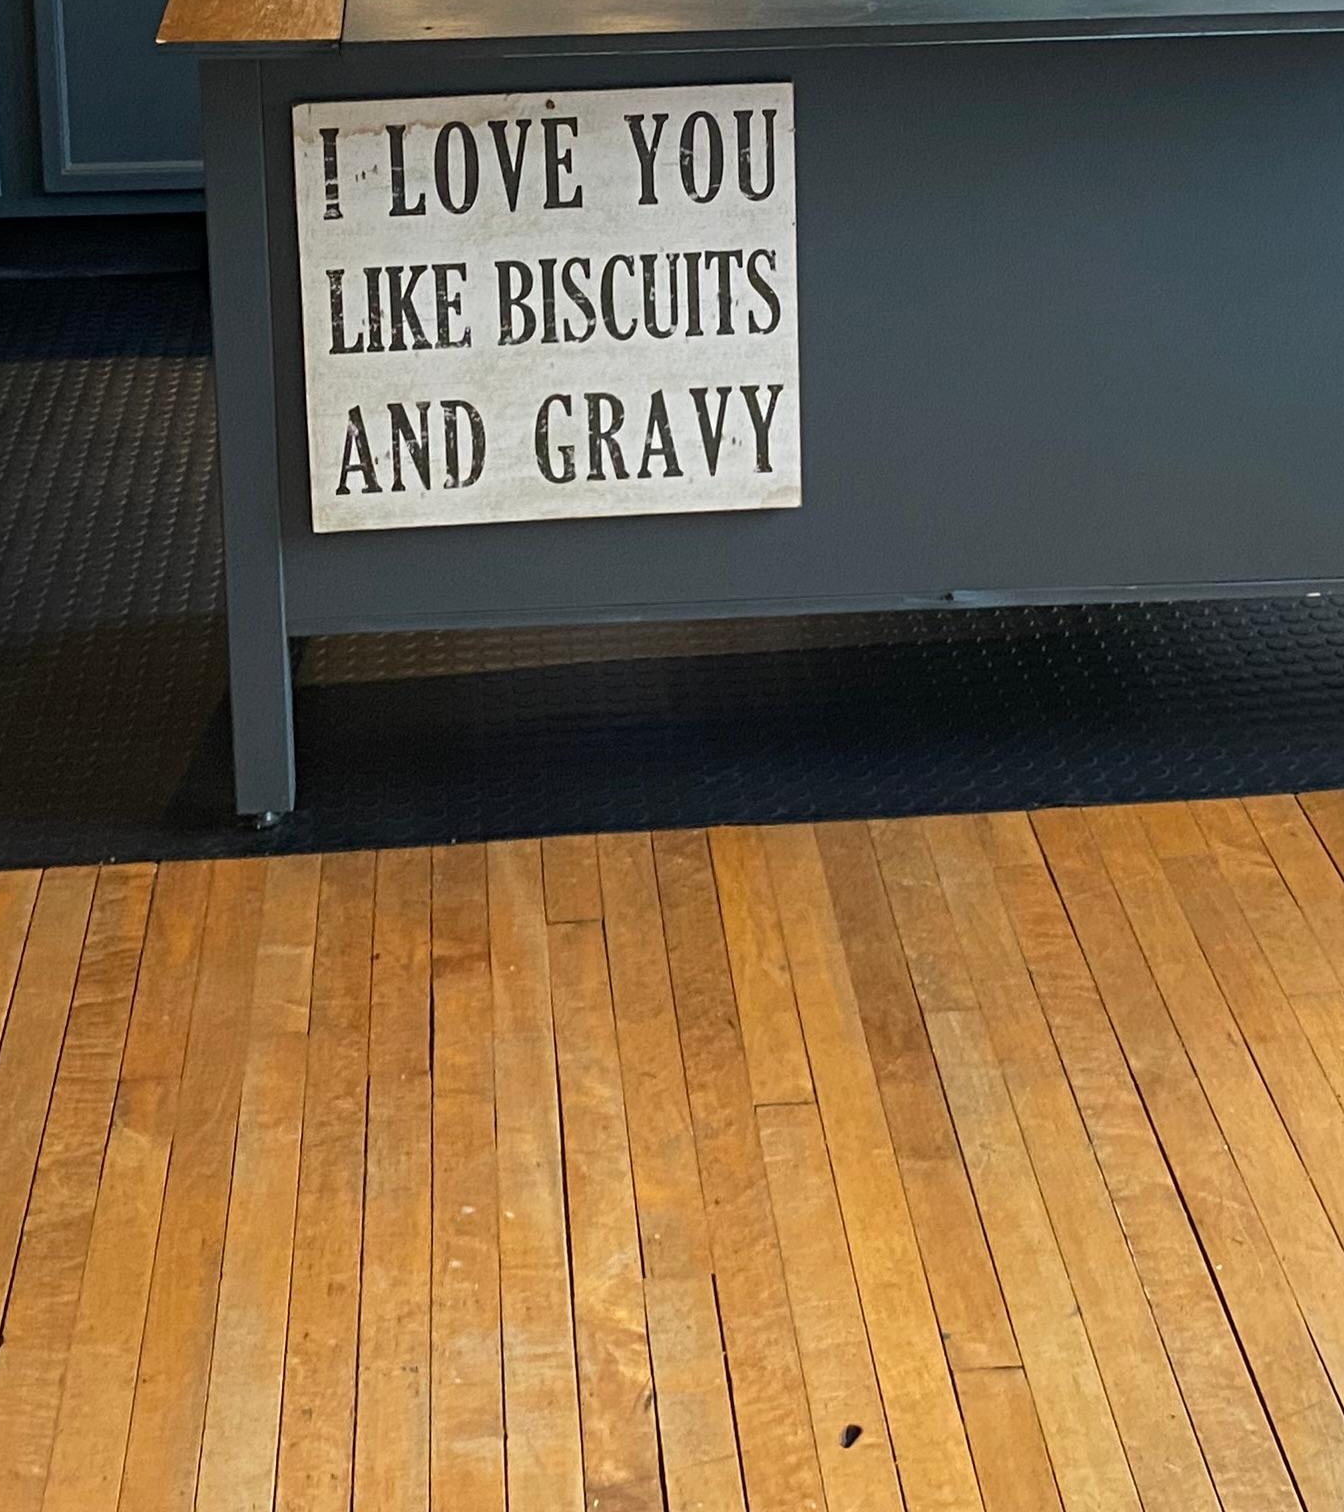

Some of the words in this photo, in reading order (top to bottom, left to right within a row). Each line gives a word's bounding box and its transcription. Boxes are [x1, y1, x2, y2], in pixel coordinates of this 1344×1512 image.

[319, 128, 343, 220] I
[385, 117, 582, 216] LOVE
[624, 109, 777, 205] YOU
[326, 263, 471, 354] LIKE
[495, 249, 780, 345] BISCUITS
[336, 400, 485, 495] AND
[535, 385, 783, 483] GRAVY
